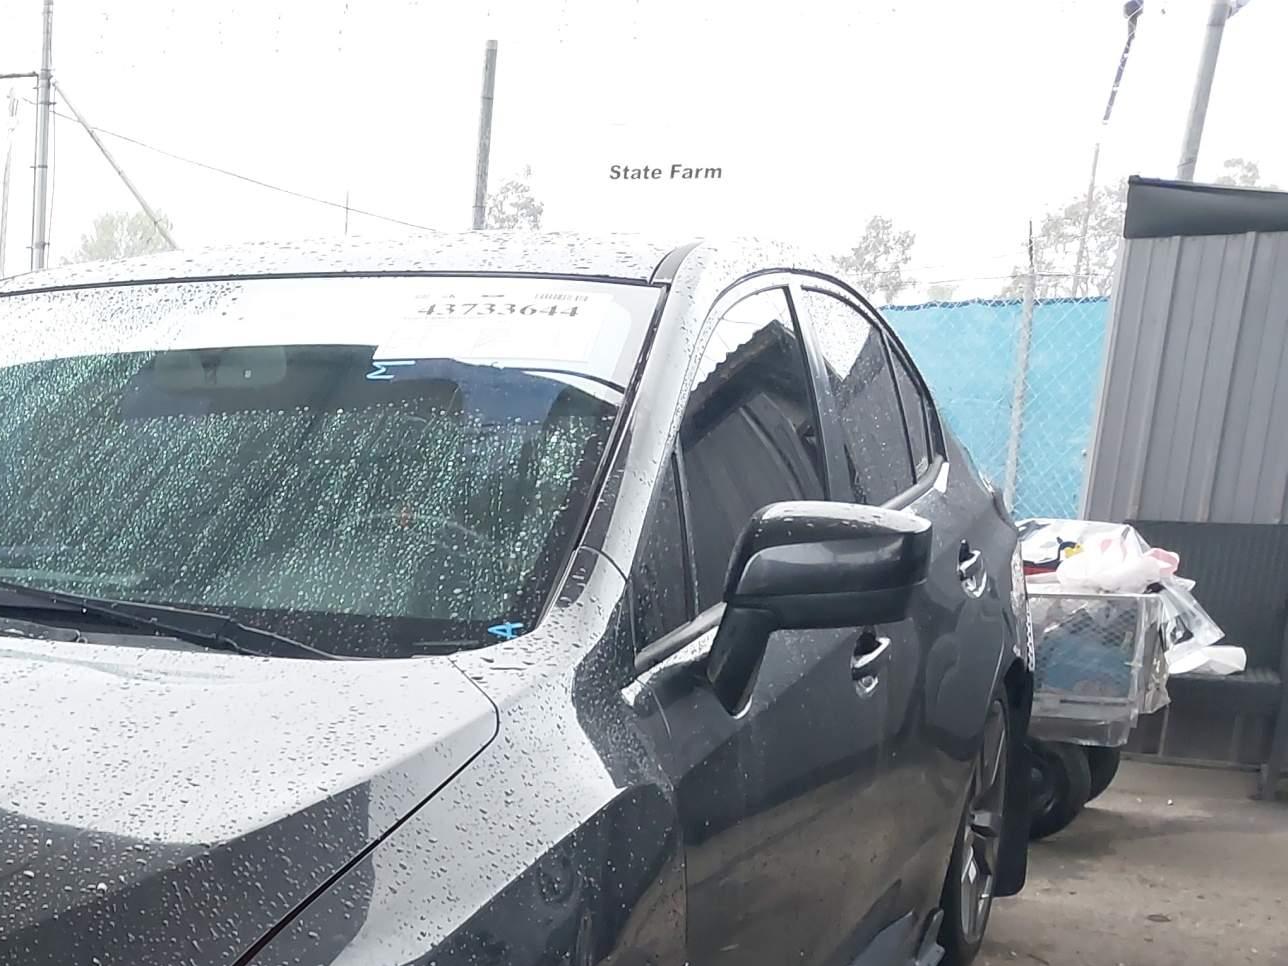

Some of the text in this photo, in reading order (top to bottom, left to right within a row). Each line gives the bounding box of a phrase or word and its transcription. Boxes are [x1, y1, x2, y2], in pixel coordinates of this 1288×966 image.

[609, 163, 722, 180] State Farm
[417, 303, 580, 317] 43733644
